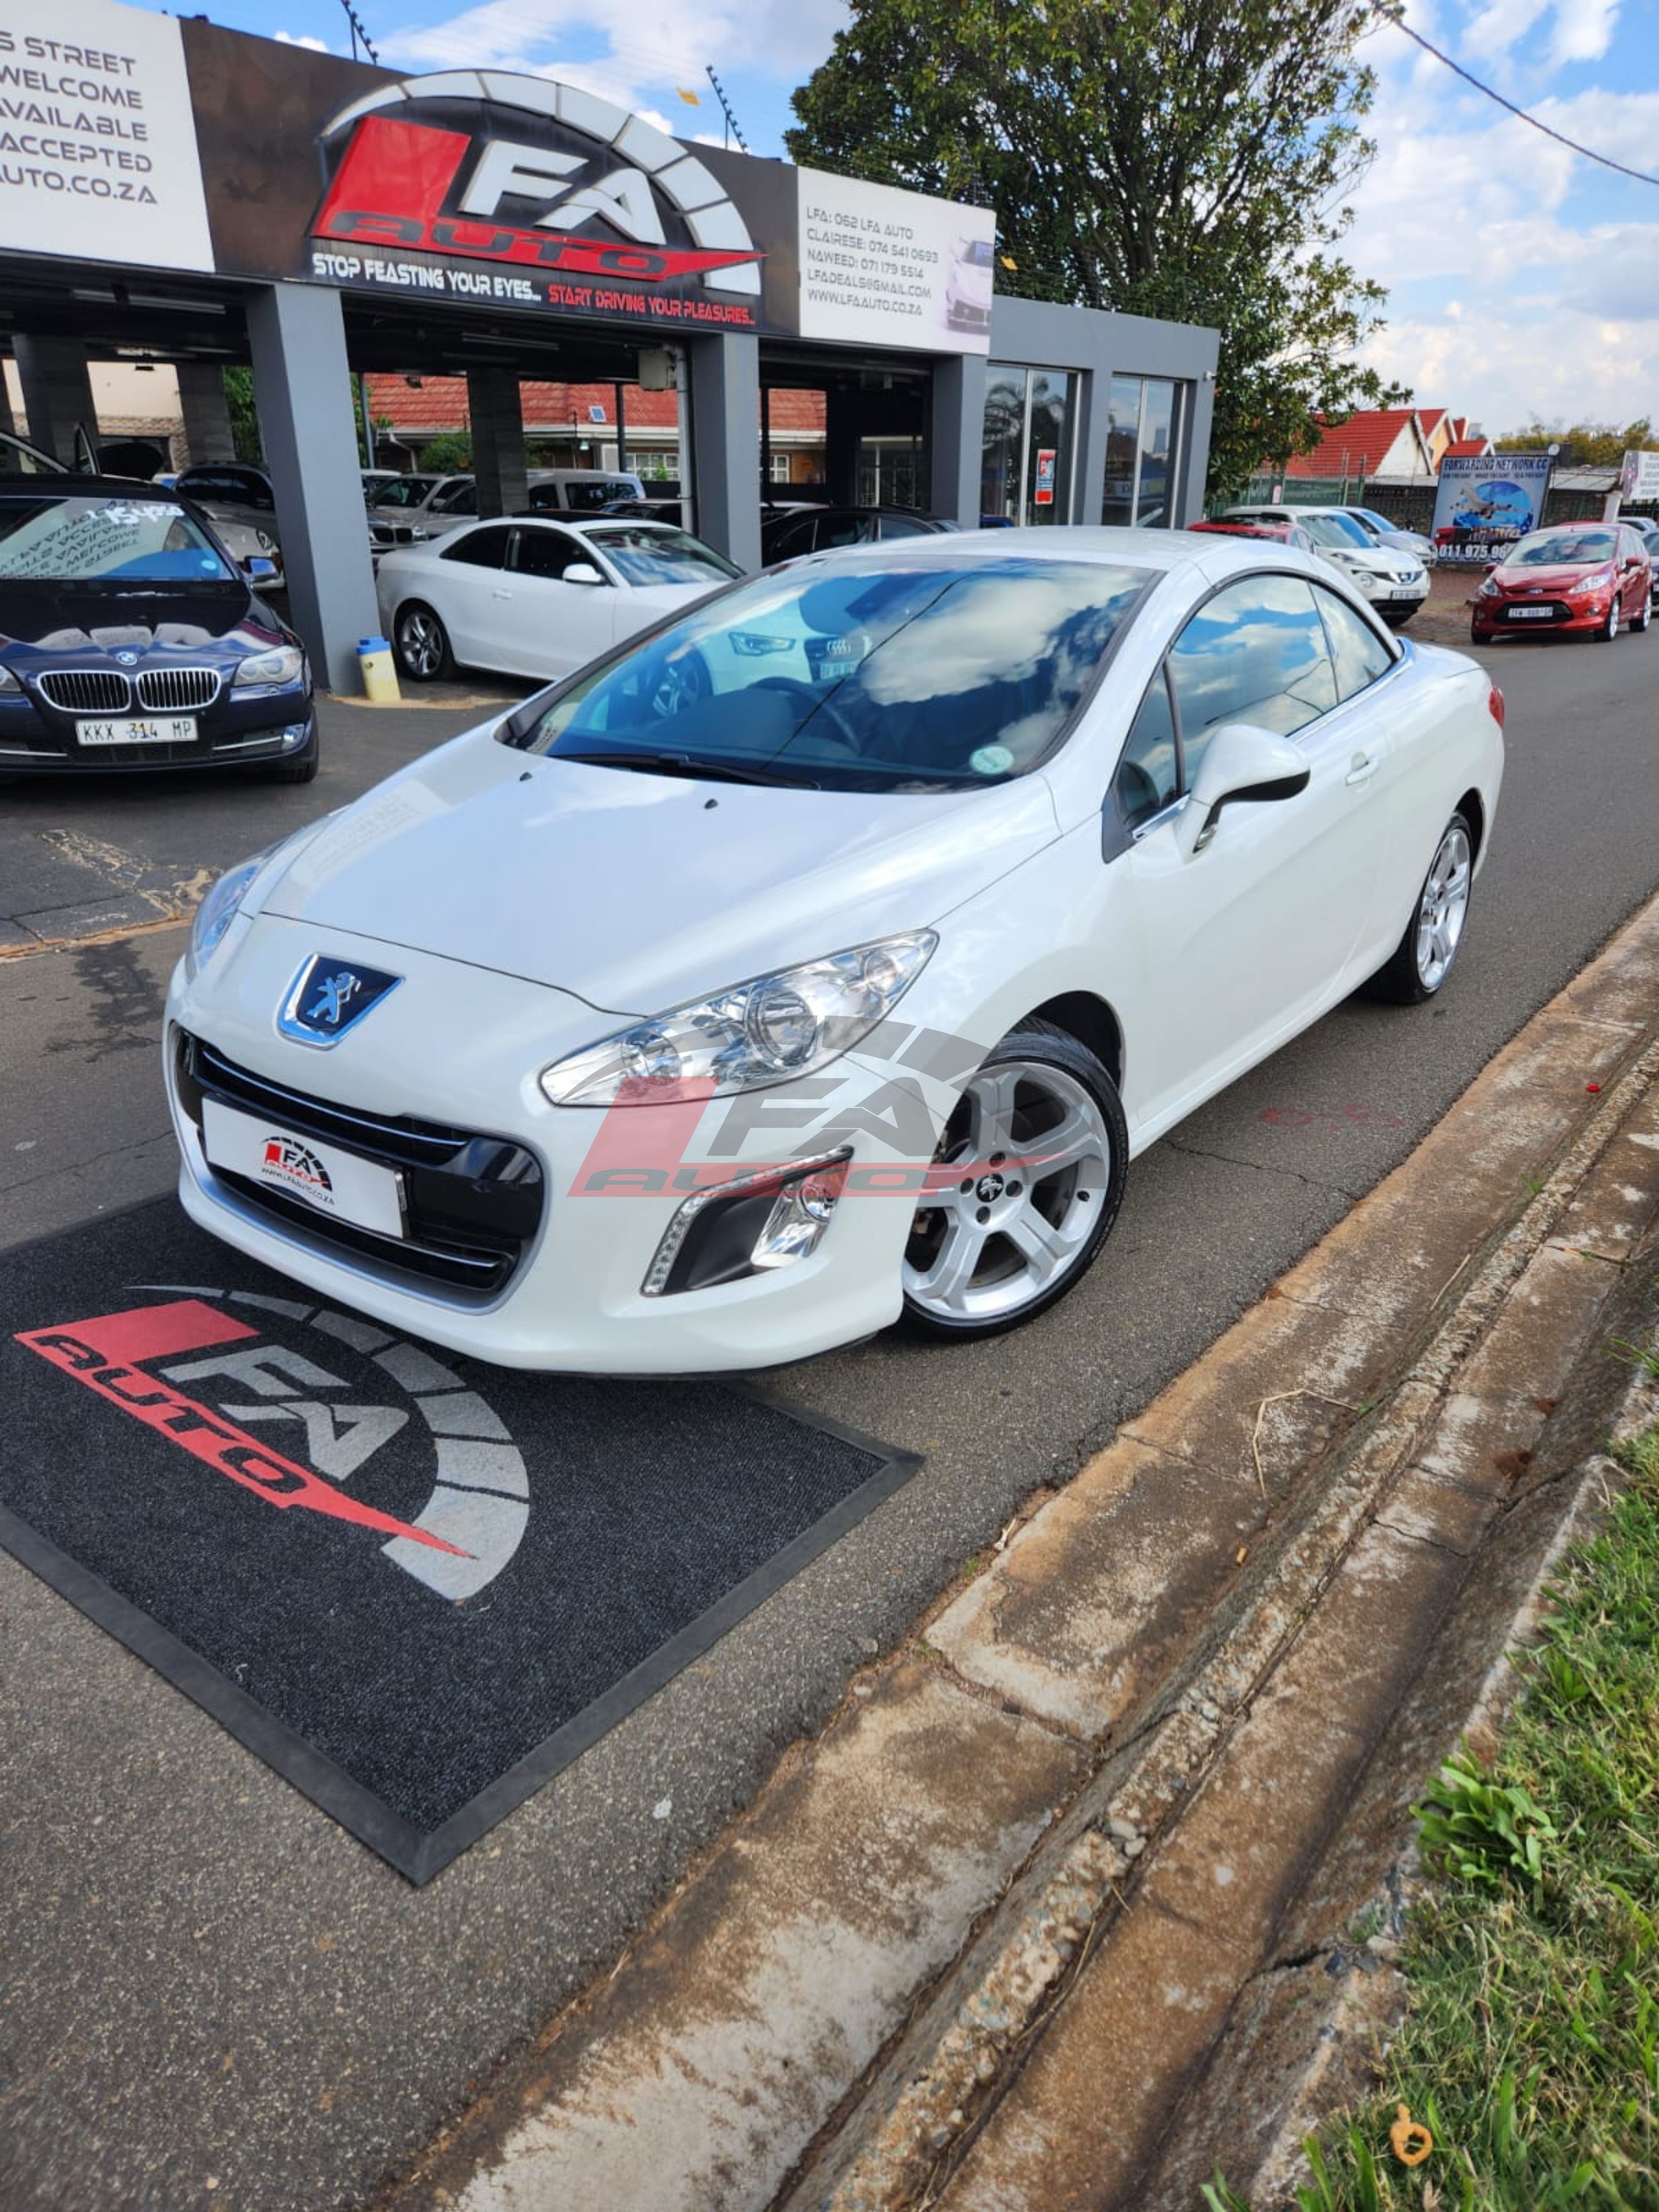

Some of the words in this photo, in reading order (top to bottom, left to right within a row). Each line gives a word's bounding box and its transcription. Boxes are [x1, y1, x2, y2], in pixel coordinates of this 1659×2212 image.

[24, 36, 136, 76] STREET
[0, 131, 153, 173] ACCEPTED
[0, 164, 158, 204] UTO.CO.ZA
[807, 206, 832, 223] LFA:
[835, 213, 858, 229] 062
[861, 218, 881, 234] LFA
[885, 224, 913, 240] AUTO
[329, 211, 668, 274] AUTO
[869, 240, 889, 254] 074
[891, 244, 909, 258] 541
[312, 253, 361, 278] STOP
[364, 259, 444, 290] FEASTING
[447, 270, 491, 296] YOUR
[494, 277, 542, 301] EYES...
[808, 248, 858, 269] NAWEED:
[901, 265, 924, 279] 5514
[548, 285, 592, 307] START
[596, 290, 646, 313] DRIVING
[648, 296, 682, 316] YOUR
[808, 289, 923, 315] WWW.LFAAUTO.CO.ZA
[1444, 458, 1495, 470] FORWARDING
[1496, 458, 1534, 470] NETWORK
[1439, 544, 1460, 558] 011
[1465, 544, 1488, 558] 975
[83, 723, 114, 742] KKX
[128, 722, 157, 739] 314
[172, 720, 191, 738] MP
[34, 1335, 307, 1493] AUTO
